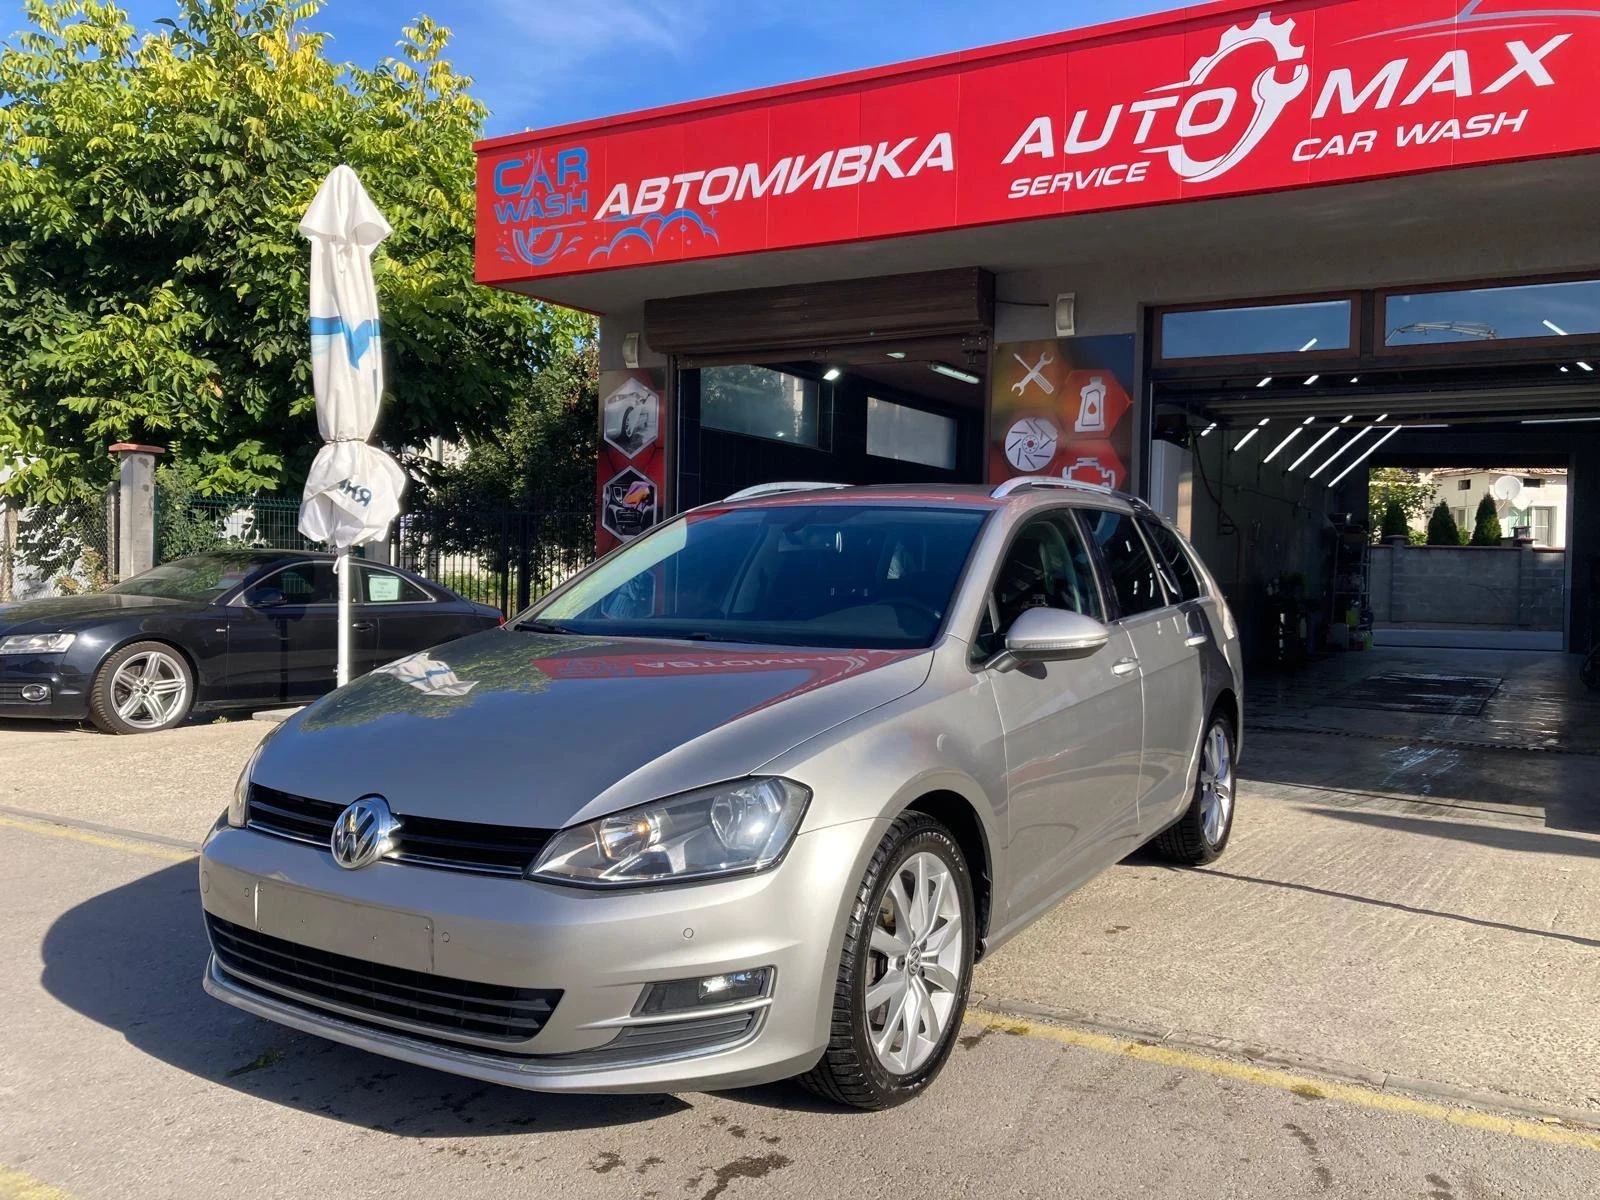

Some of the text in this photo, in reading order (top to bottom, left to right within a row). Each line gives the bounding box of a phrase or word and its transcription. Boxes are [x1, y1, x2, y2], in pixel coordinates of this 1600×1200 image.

[1001, 33, 1574, 164] AUTO MAX
[1291, 108, 1529, 162] CAR WASH
[494, 147, 588, 198] CAR
[592, 131, 954, 221] АВТОМИВКА
[1007, 160, 1151, 200] SERVICE
[494, 189, 588, 225] WASH
